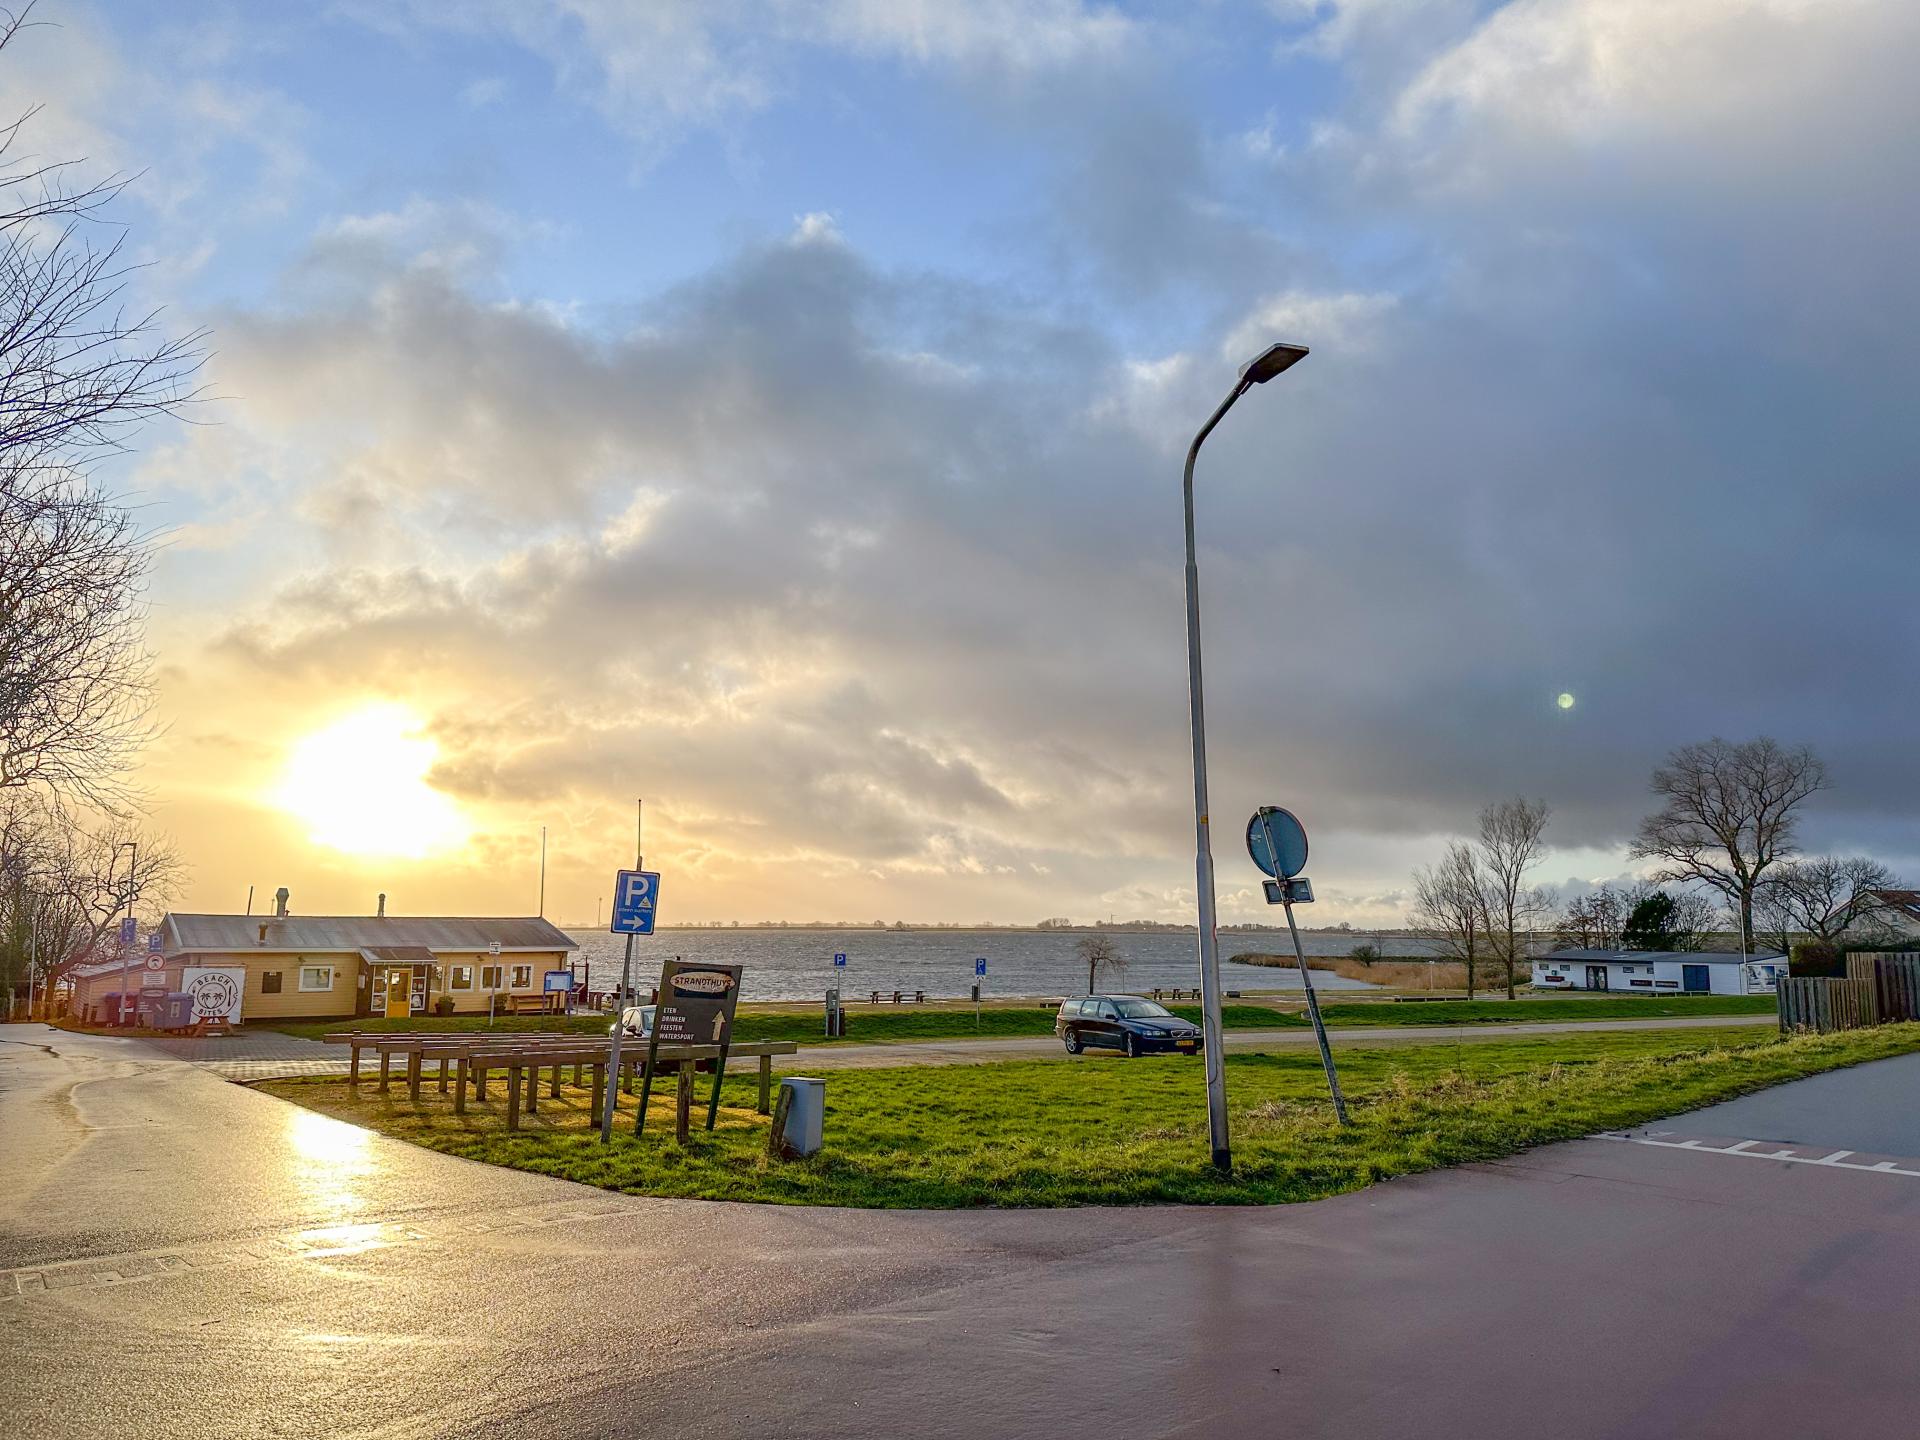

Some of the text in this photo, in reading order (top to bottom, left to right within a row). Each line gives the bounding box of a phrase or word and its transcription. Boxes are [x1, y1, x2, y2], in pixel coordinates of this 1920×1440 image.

[625, 875, 649, 906] P
[124, 919, 133, 929] P
[151, 935, 160, 946] P
[836, 955, 844, 965] P
[977, 959, 985, 968] P
[196, 974, 231, 986] BEACH
[198, 1008, 223, 1016] BITES
[661, 1015, 686, 1023] DRINKEN
[659, 1033, 695, 1041] WATERSPORT
